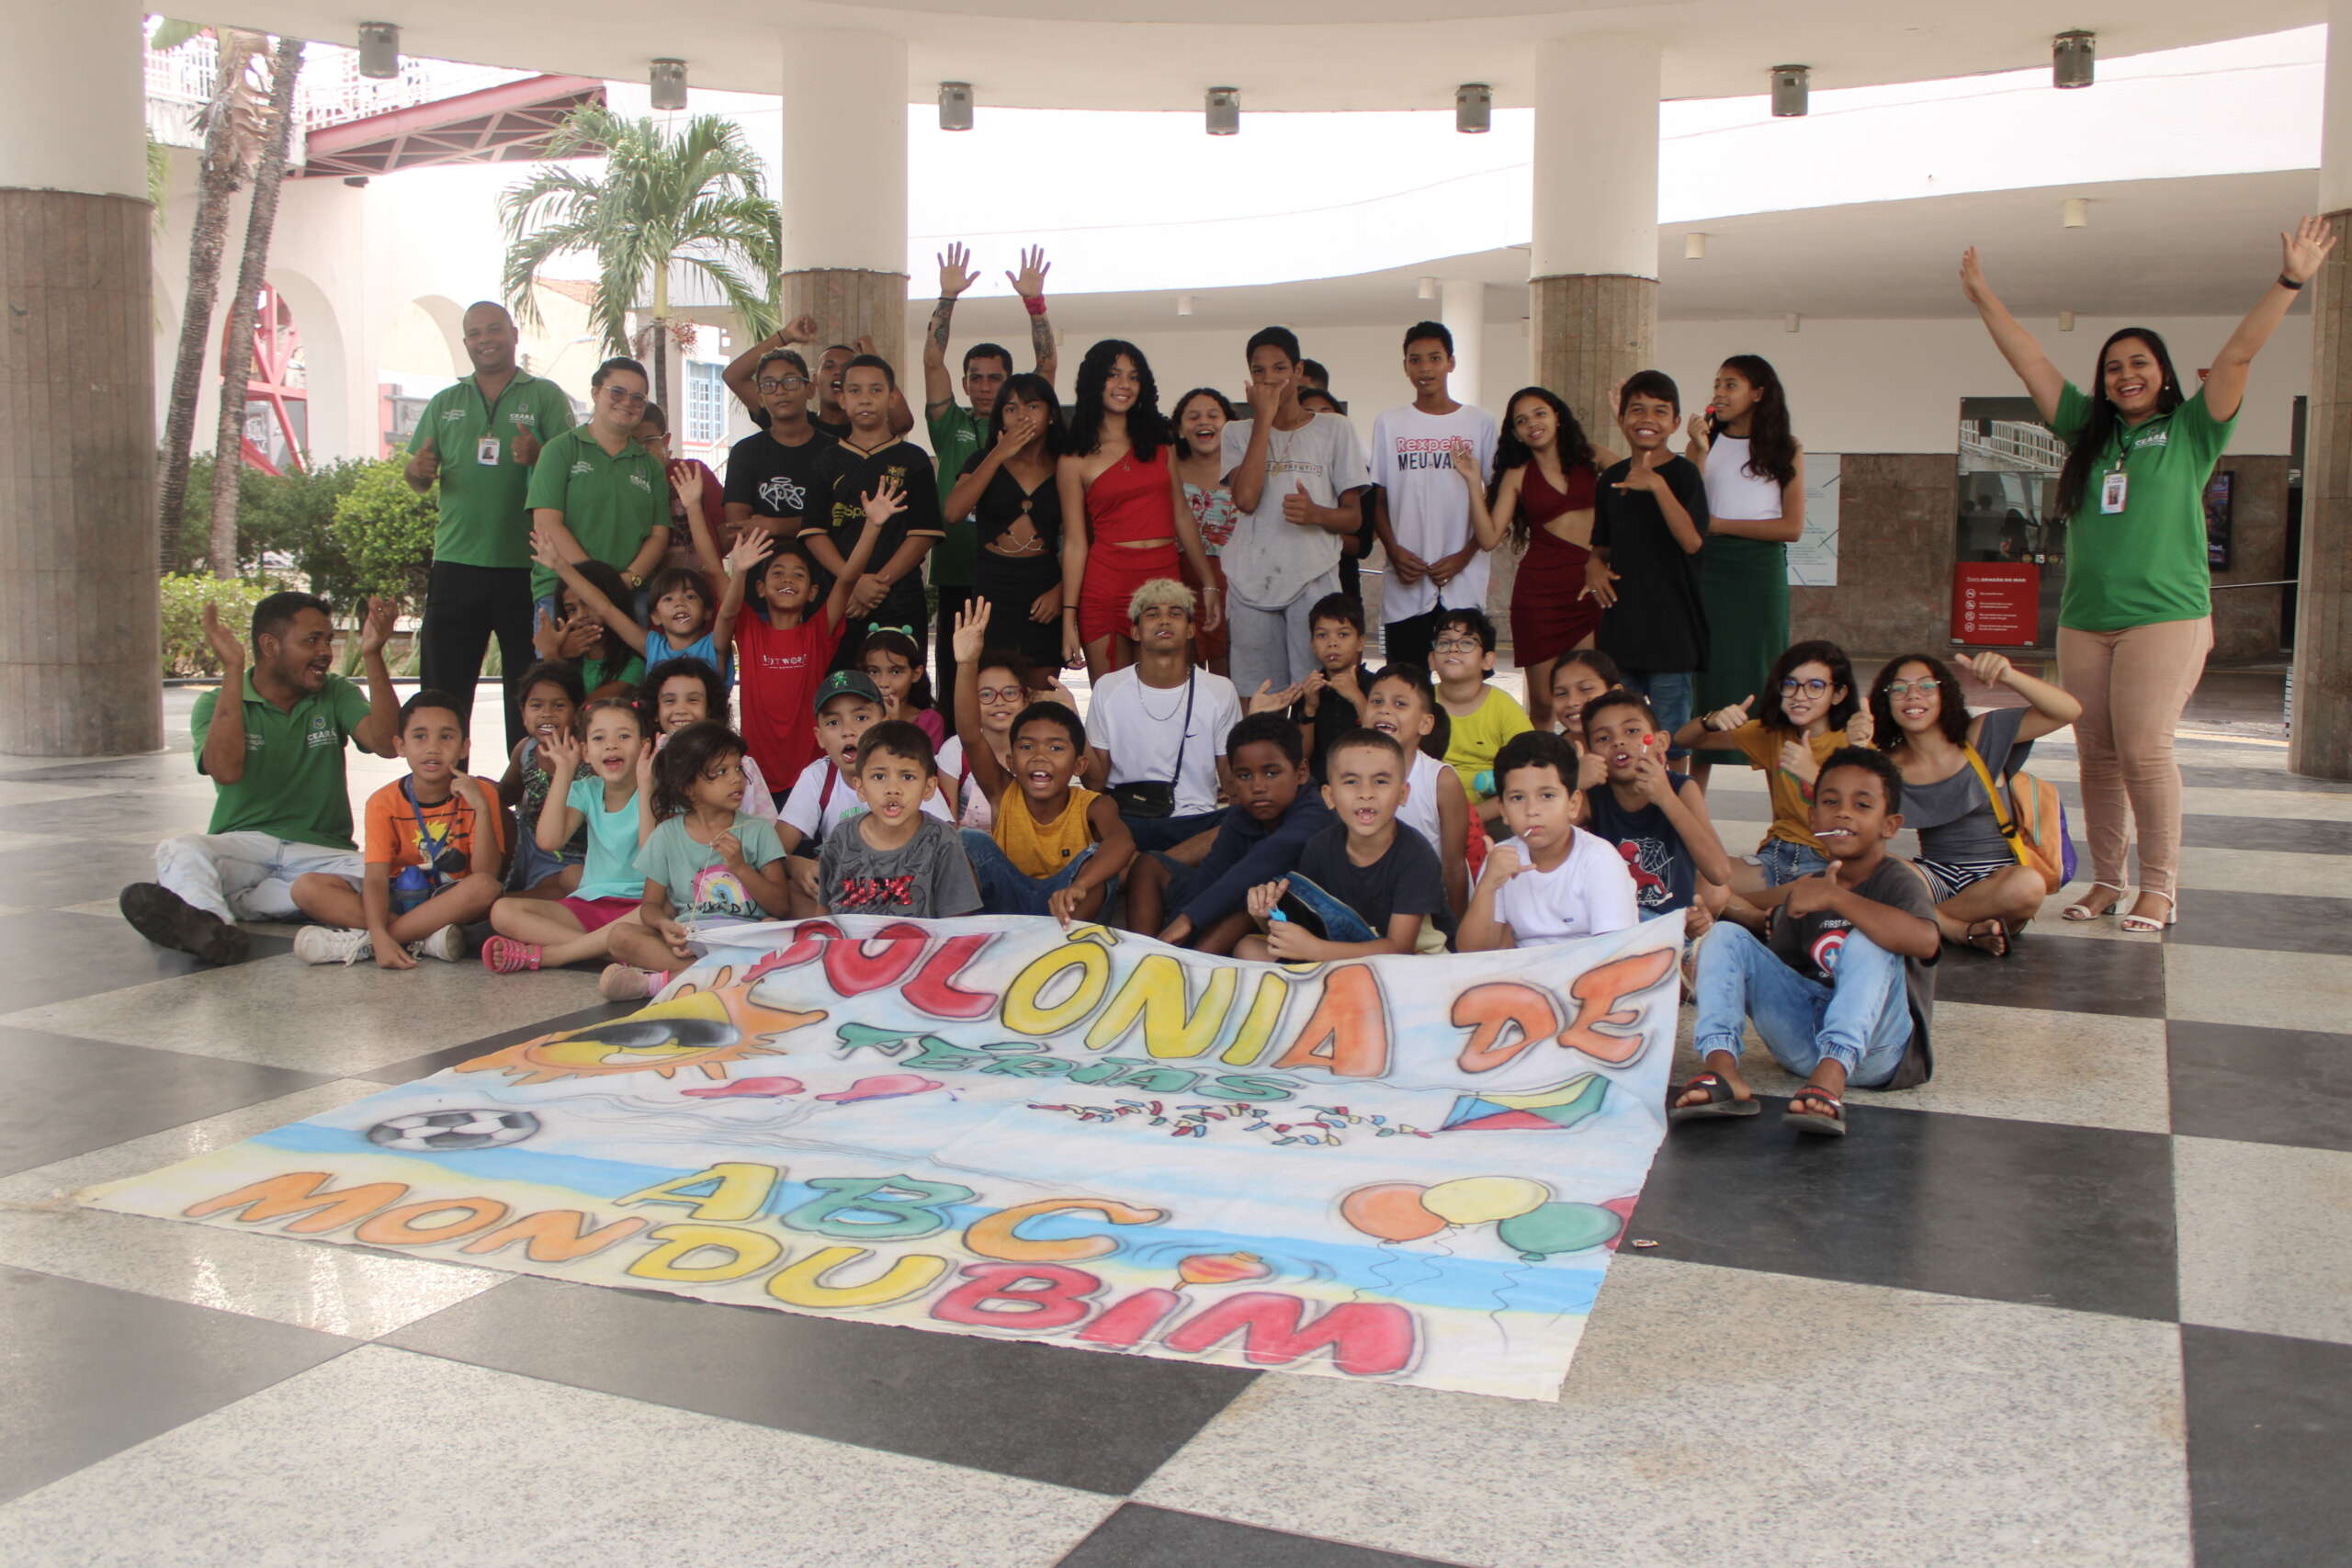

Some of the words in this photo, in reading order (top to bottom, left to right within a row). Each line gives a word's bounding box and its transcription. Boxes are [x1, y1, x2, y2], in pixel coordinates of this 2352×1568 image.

[1397, 453, 1427, 471] MEU
[307, 727, 337, 741] CEARÁ
[1451, 946, 1676, 1073] DE
[615, 1162, 1165, 1263] ABC
